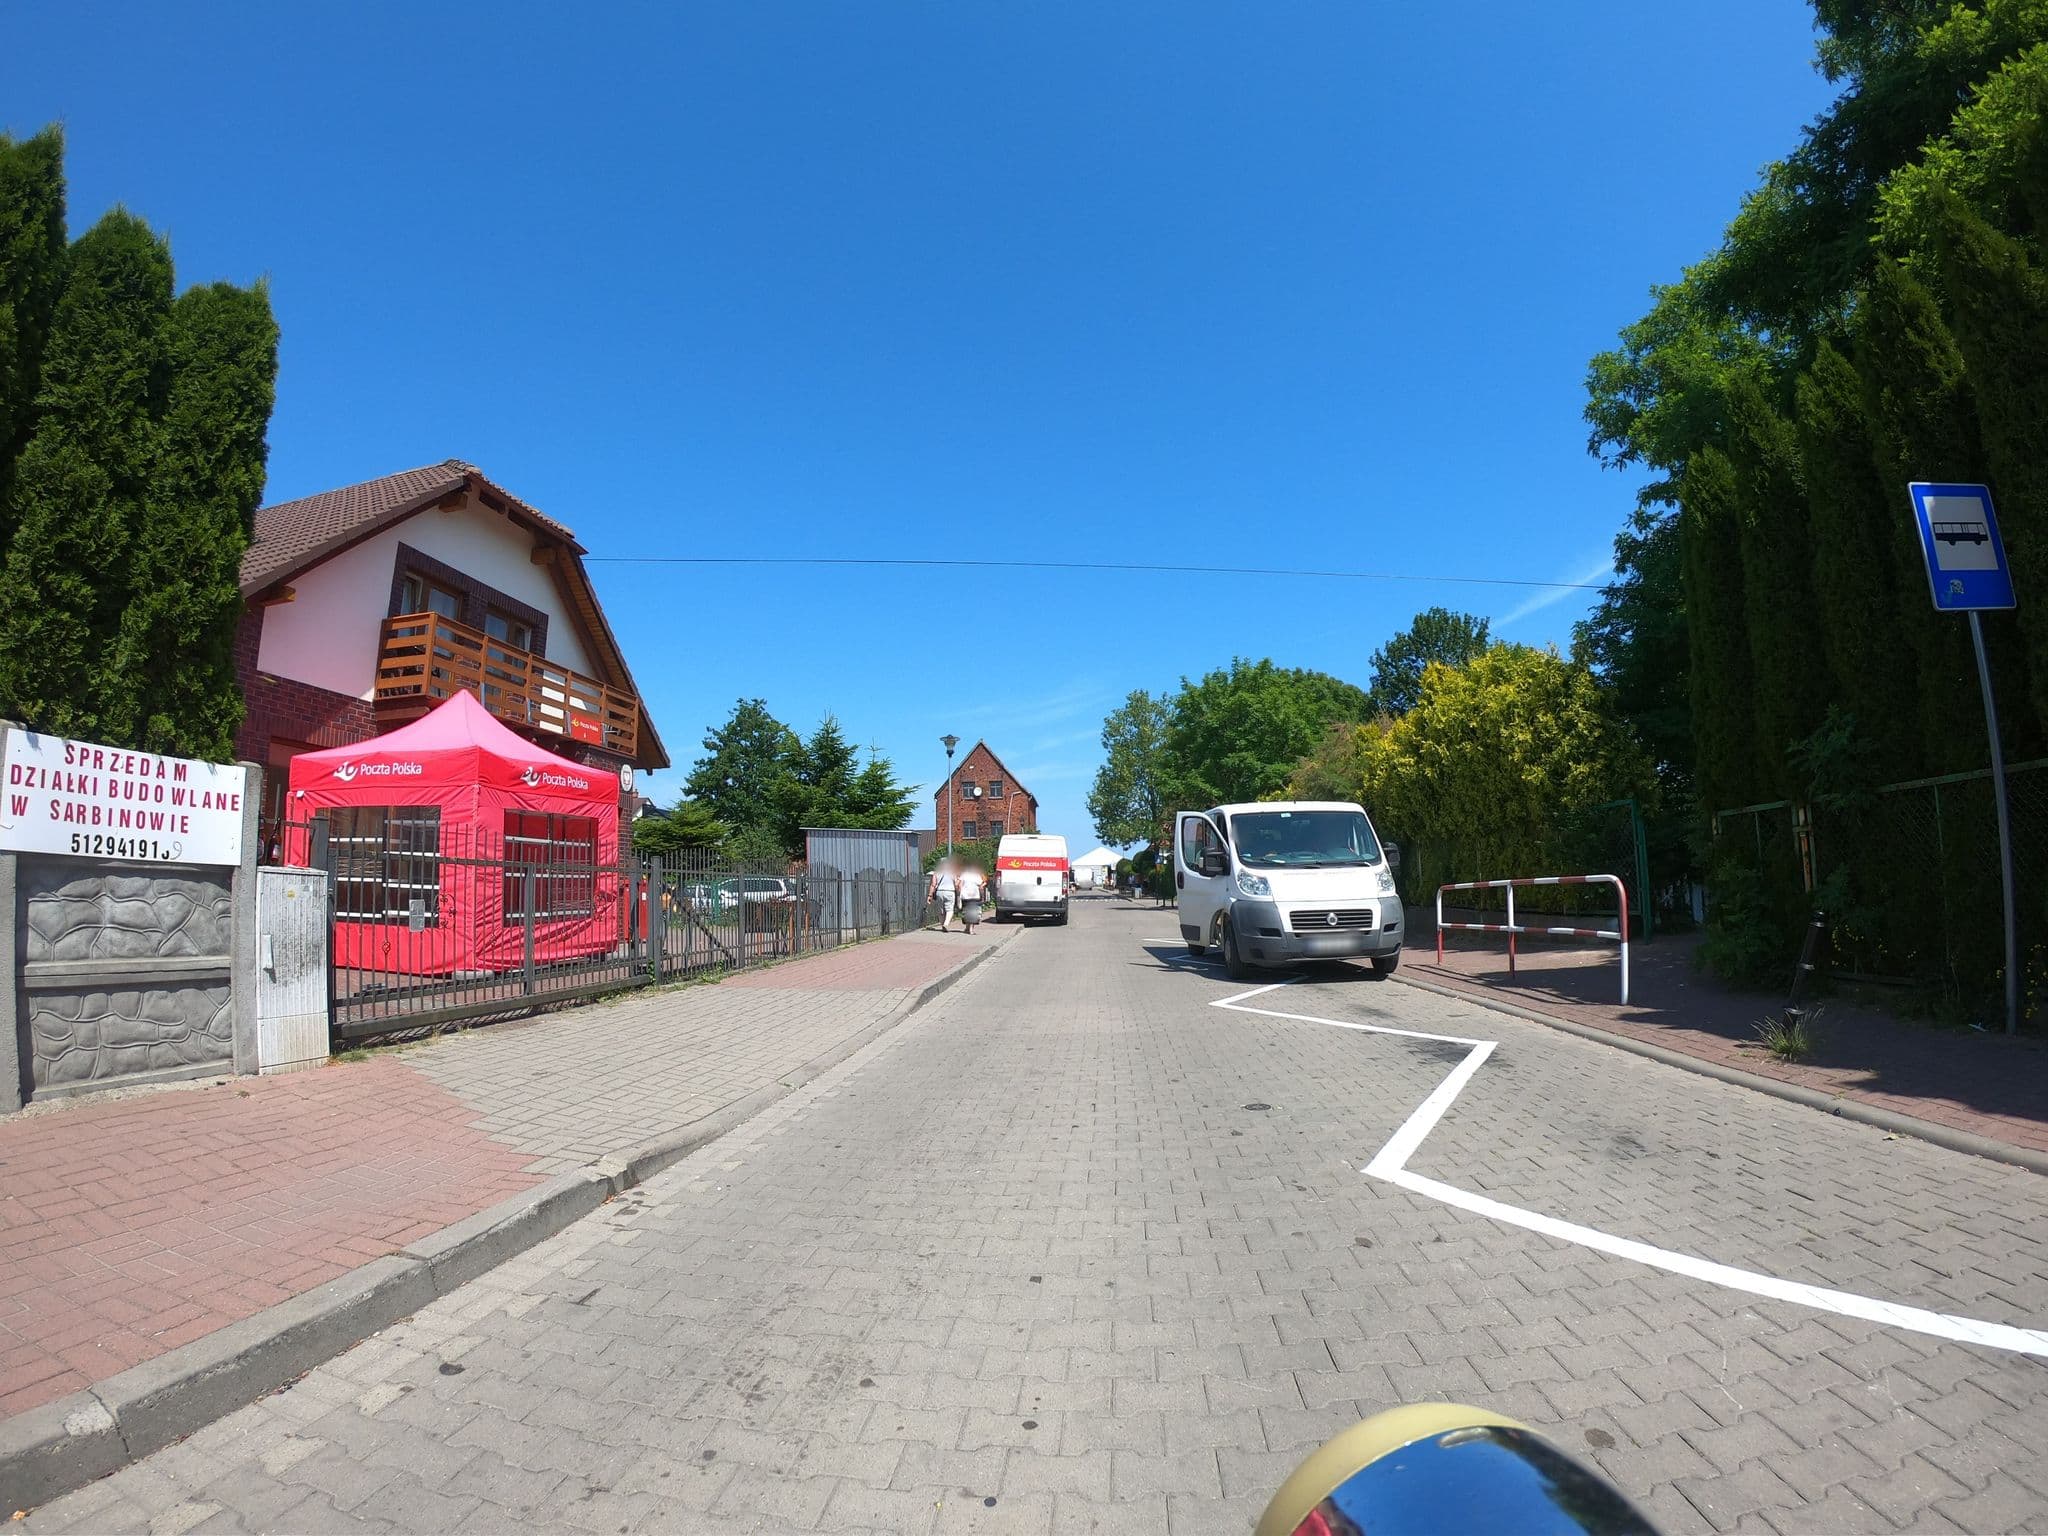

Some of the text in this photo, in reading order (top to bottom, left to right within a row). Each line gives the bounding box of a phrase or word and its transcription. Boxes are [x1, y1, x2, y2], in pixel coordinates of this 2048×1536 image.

[64, 744, 187, 782] SPRZEDAM
[361, 762, 422, 776] Poczta Polska
[542, 772, 589, 790] Poczta Polska
[10, 764, 240, 811] DZIAŁKI BUDOWLANE
[11, 794, 189, 834] W SARBINOWIE
